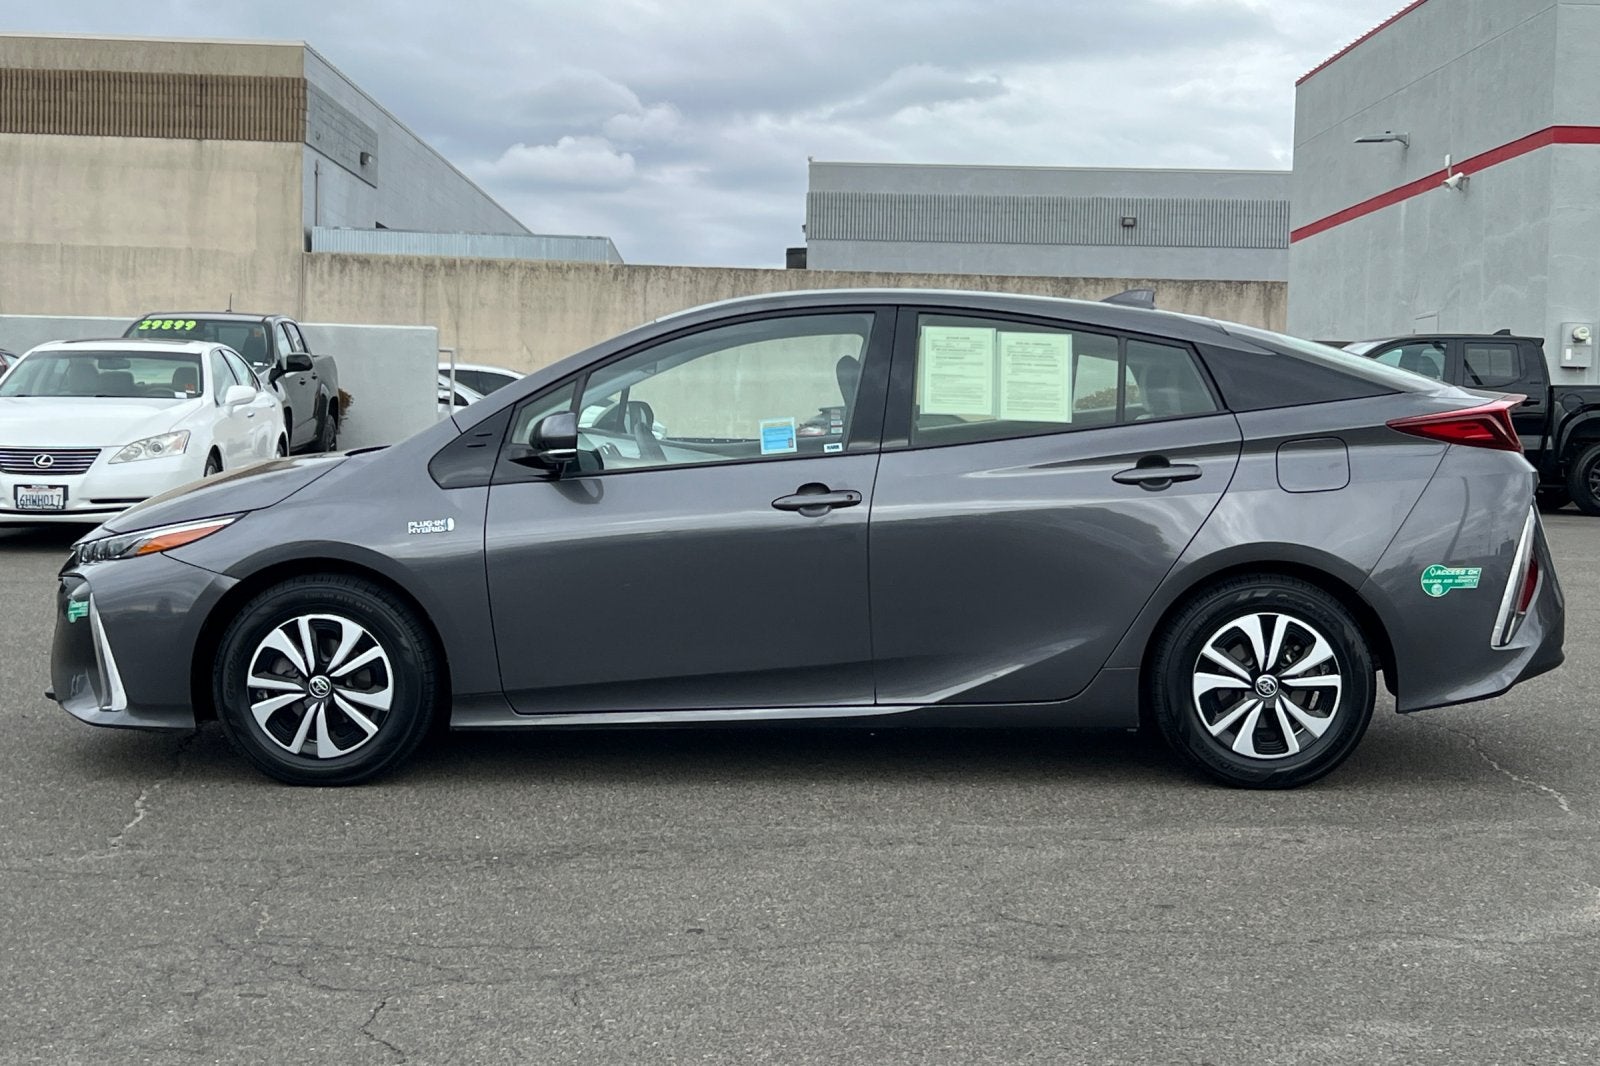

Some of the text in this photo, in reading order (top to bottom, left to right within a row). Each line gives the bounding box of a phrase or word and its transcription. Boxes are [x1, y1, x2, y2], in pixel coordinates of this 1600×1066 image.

[138, 320, 197, 330] 29899
[407, 519, 444, 528] PLUG-IN
[407, 525, 446, 534] HYBRID
